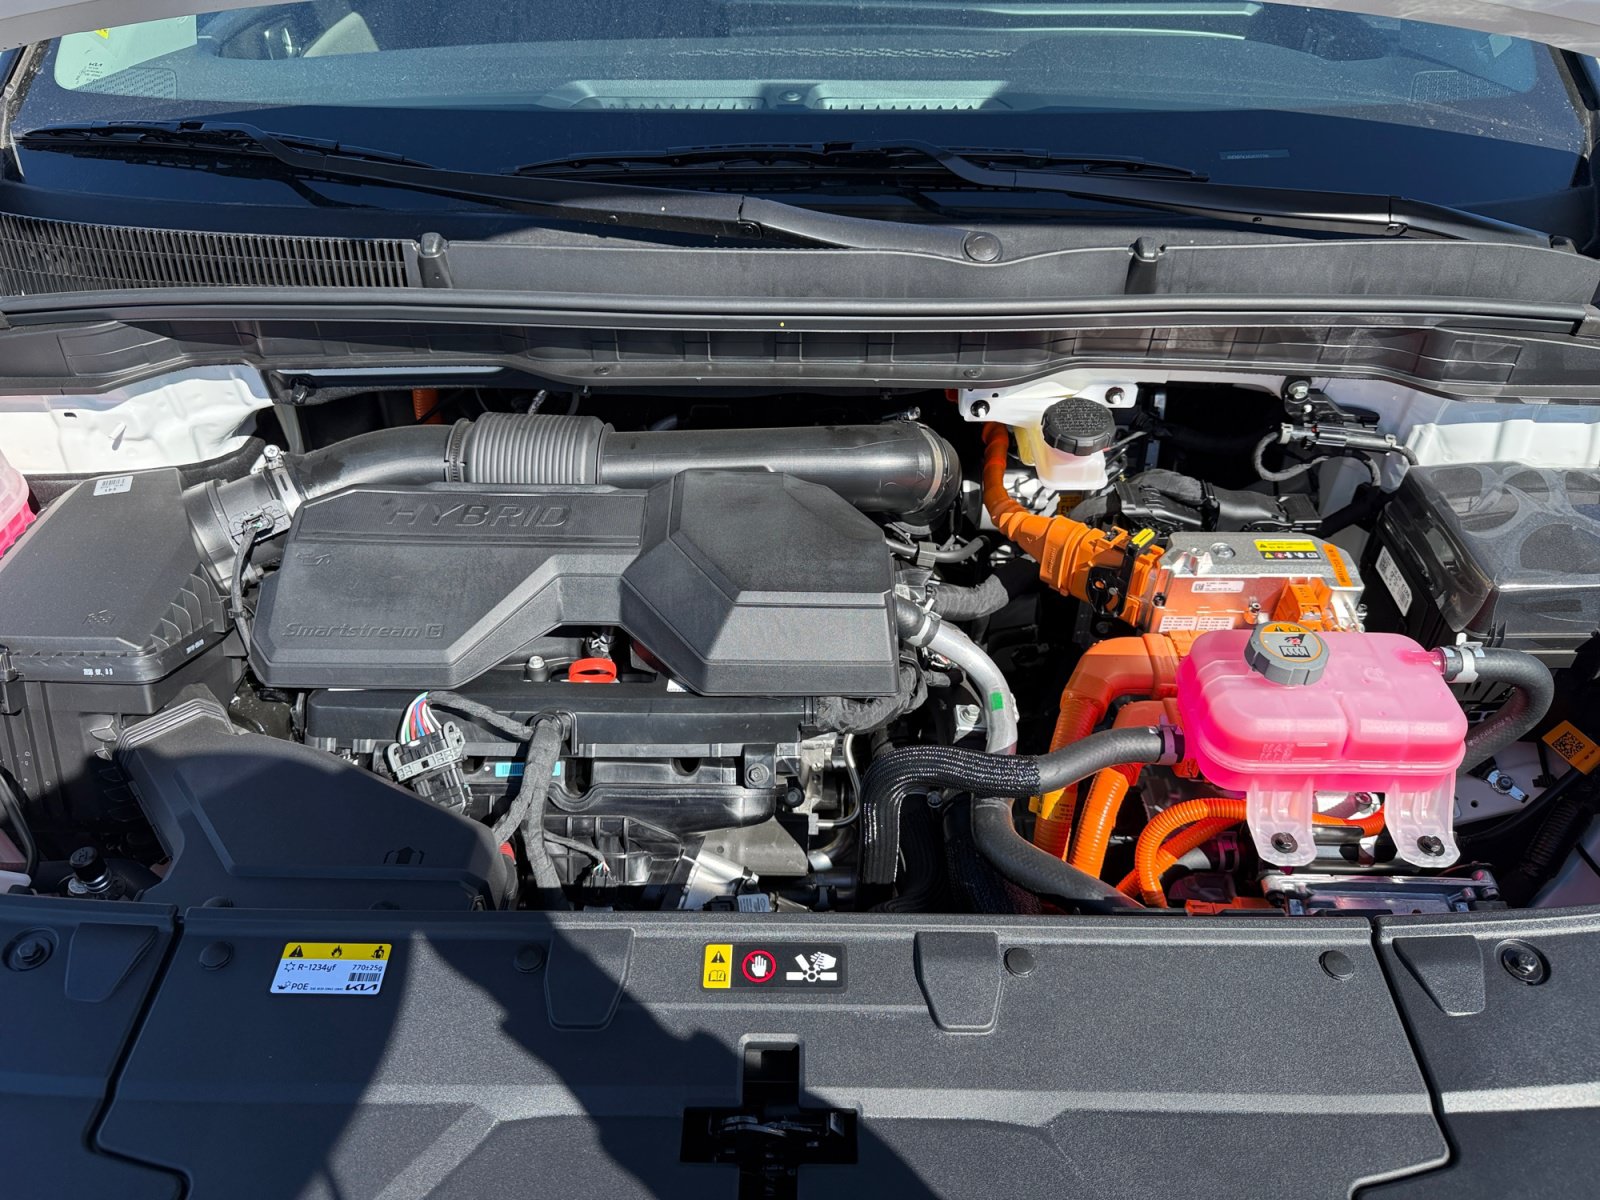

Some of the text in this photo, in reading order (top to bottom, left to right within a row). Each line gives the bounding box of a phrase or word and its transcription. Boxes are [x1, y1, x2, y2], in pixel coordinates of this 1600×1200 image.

[386, 503, 571, 527] HYBRID
[282, 622, 444, 639] Smartstream G
[297, 963, 337, 972] R-1234yf
[352, 964, 383, 972] 770±25g
[291, 983, 309, 991] POE
